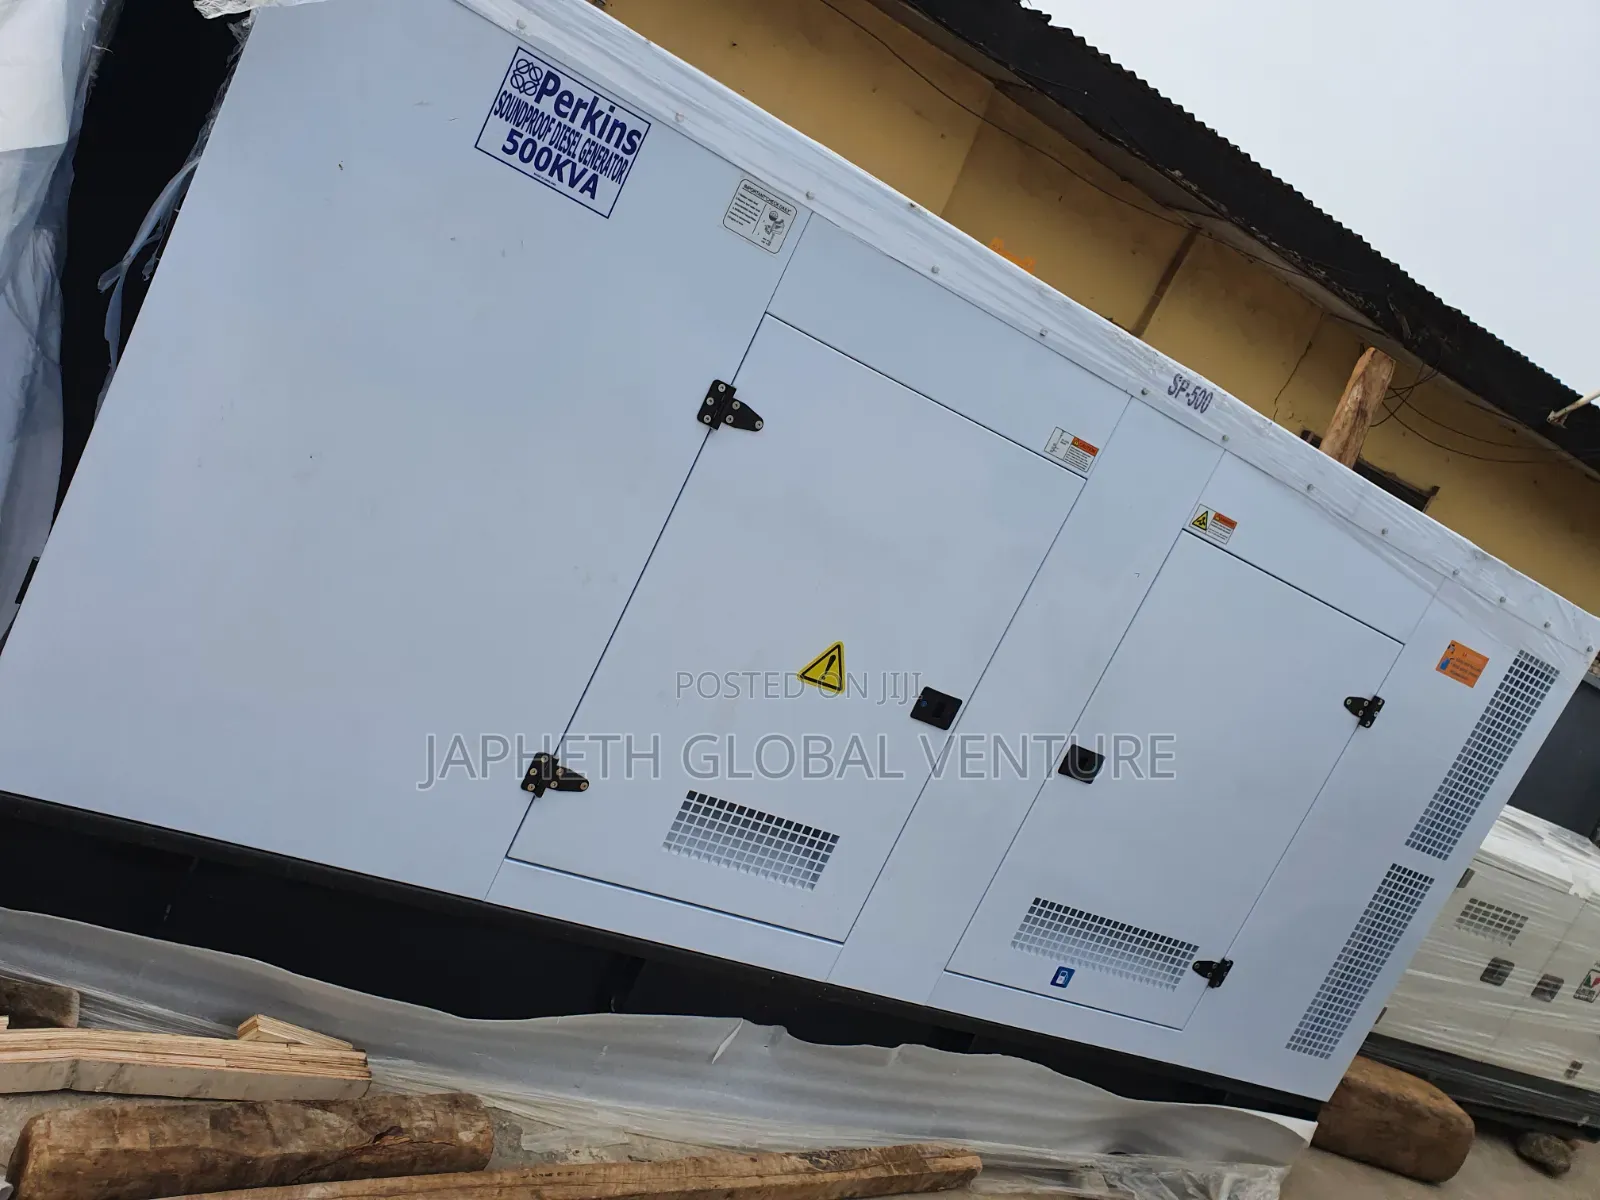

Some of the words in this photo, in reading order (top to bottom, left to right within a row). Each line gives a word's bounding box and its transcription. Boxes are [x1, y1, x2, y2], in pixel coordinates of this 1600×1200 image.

[493, 89, 557, 142] SOUNDPROOF
[548, 120, 583, 159] DIESEL
[577, 137, 629, 185] GENERATOR
[533, 70, 643, 156] Perkins
[501, 127, 599, 200] 500KVA
[1167, 373, 1214, 414] SP-500
